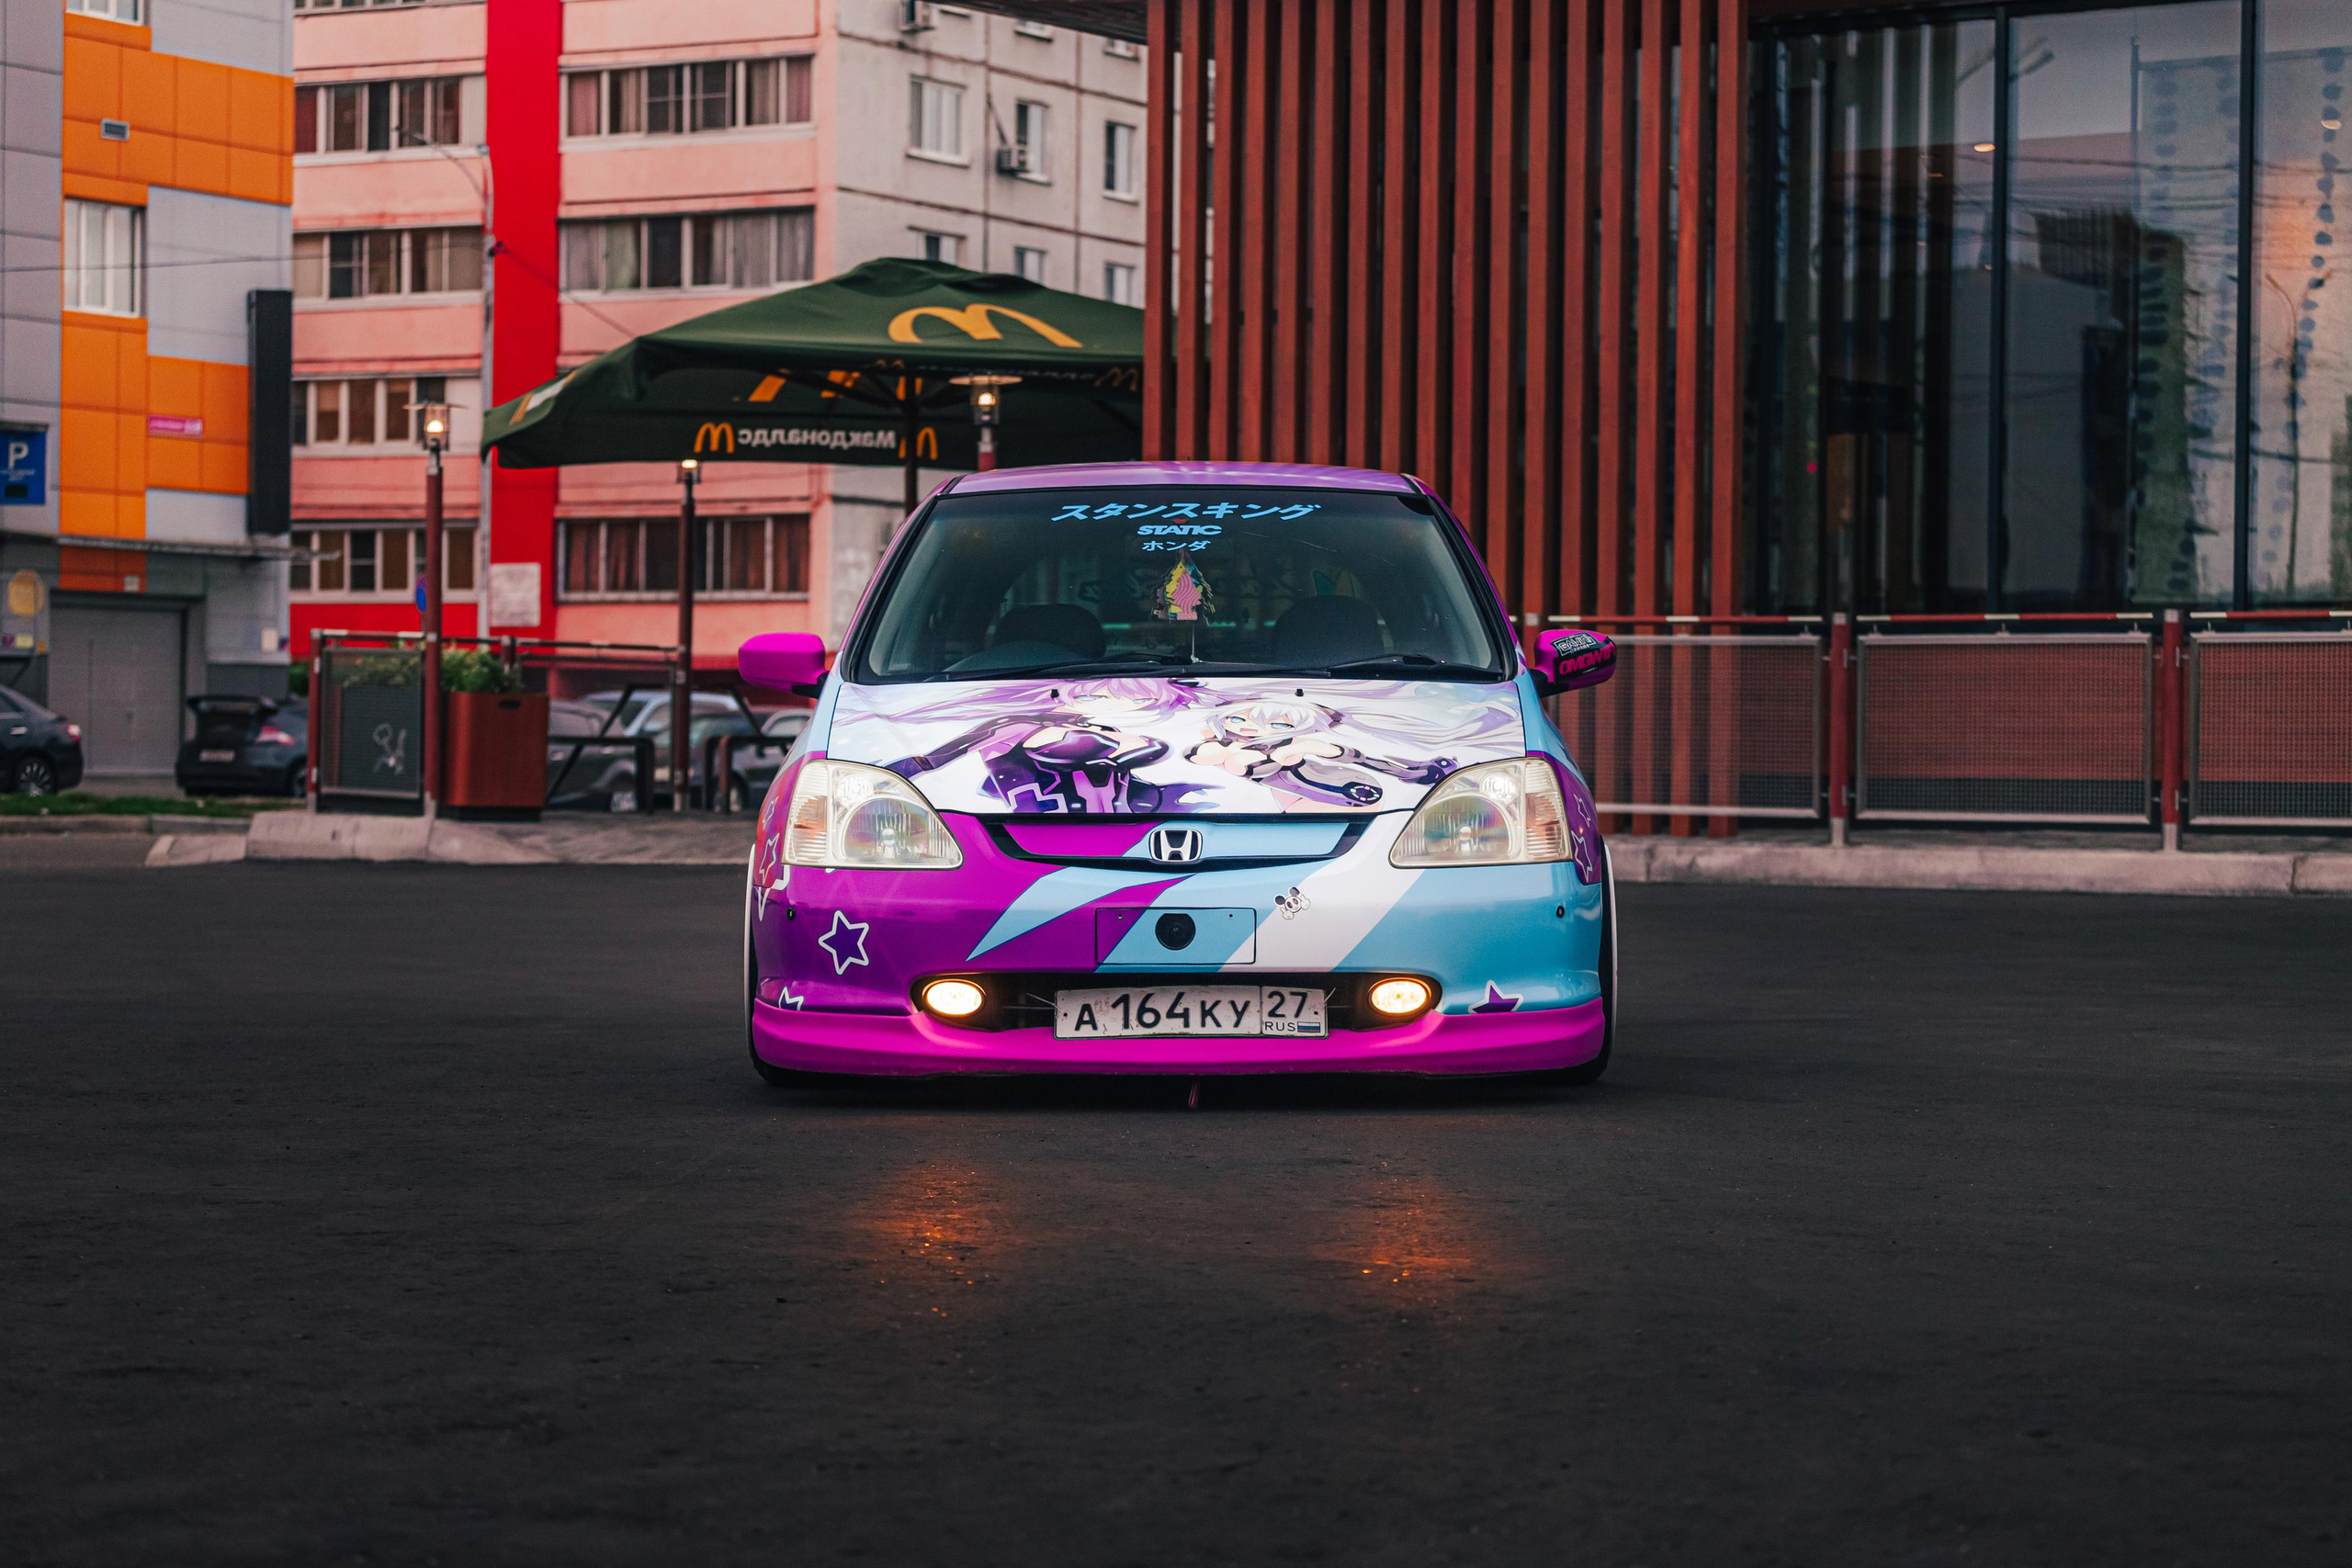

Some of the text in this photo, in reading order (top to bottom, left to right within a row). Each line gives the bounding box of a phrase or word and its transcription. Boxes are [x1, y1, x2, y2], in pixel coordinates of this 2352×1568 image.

[1051, 502, 1321, 522] スタンスキング
[1137, 525, 1223, 536] STATIC
[1142, 540, 1211, 551] ホンダ
[1267, 990, 1309, 1019] 27
[1264, 1021, 1296, 1032] RUS
